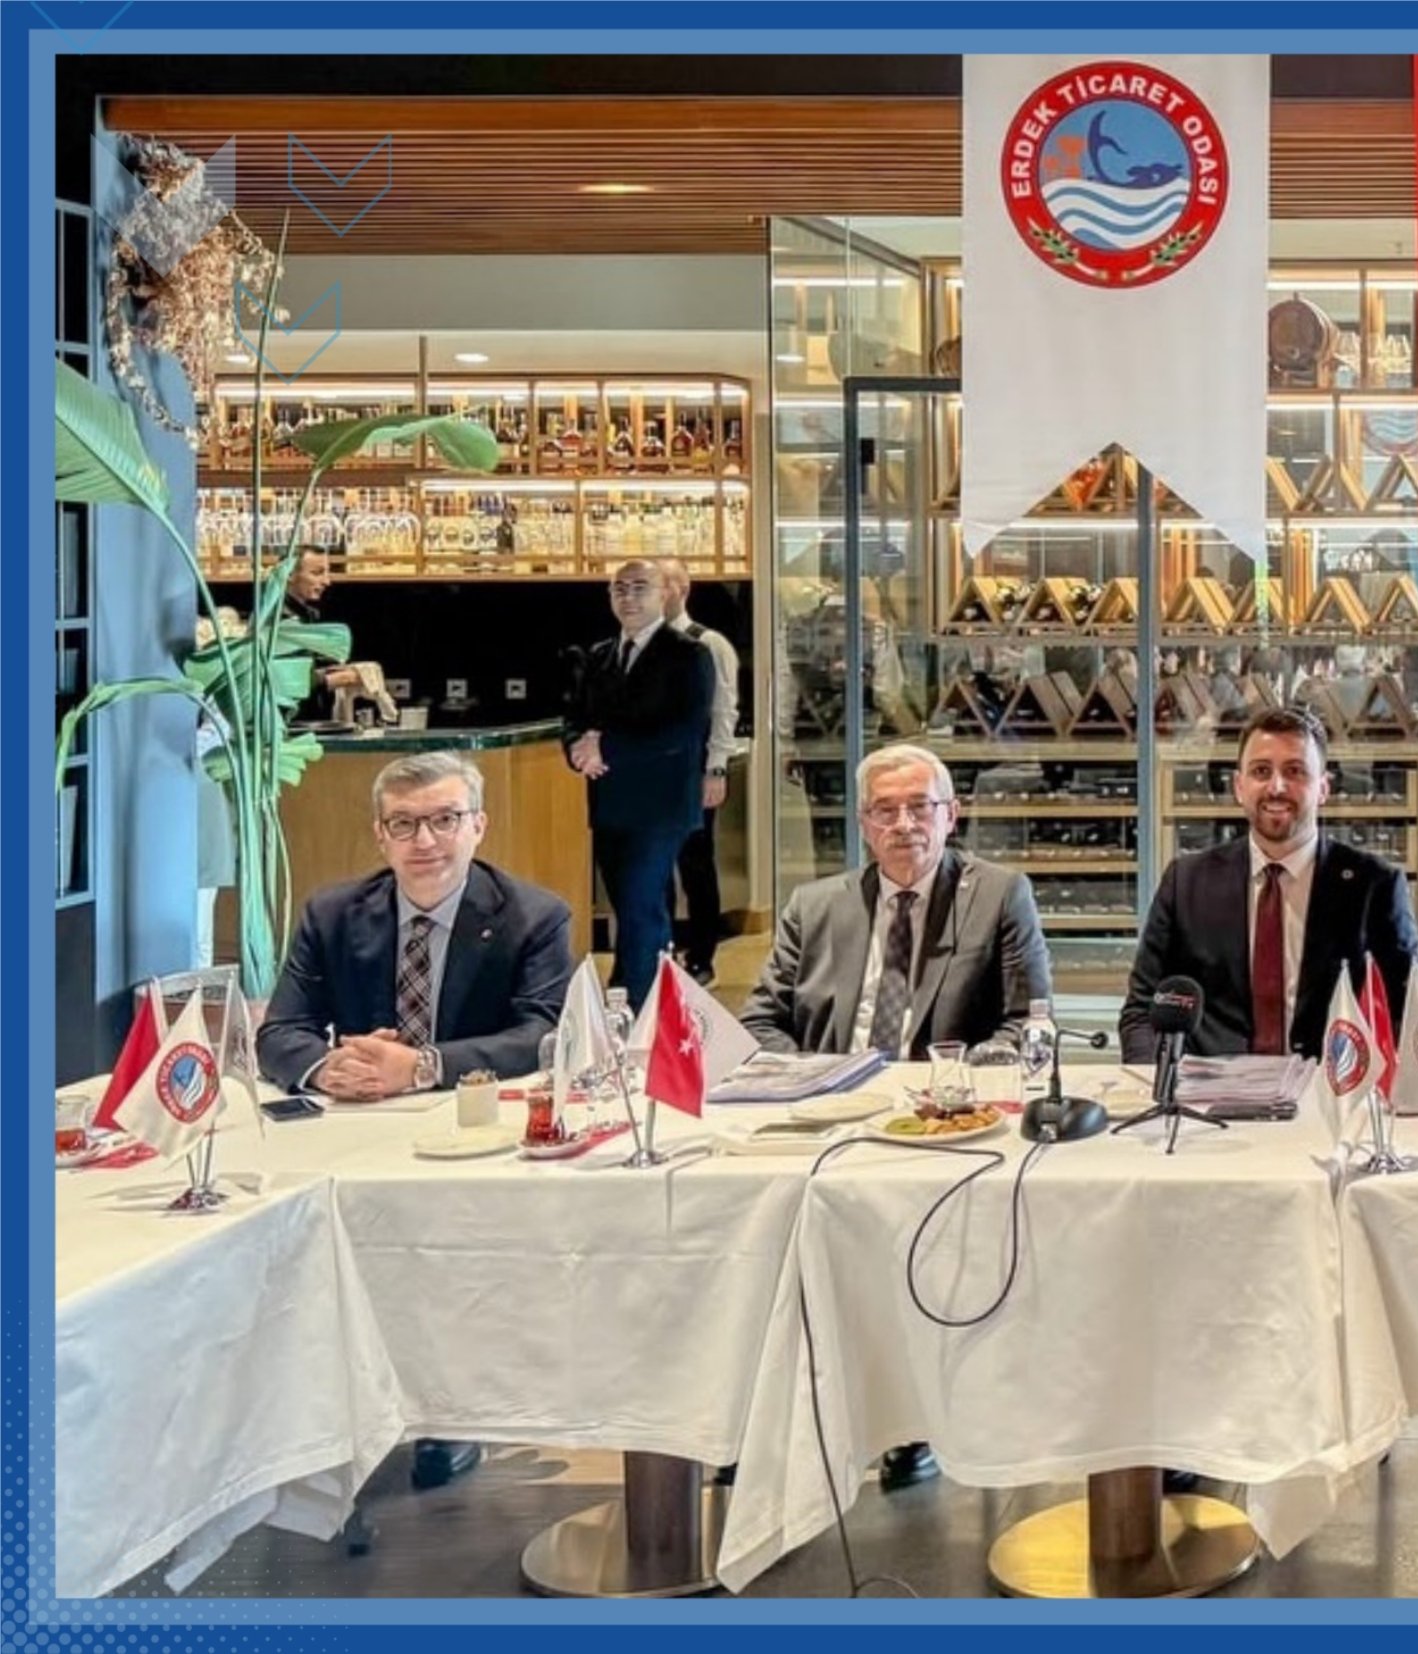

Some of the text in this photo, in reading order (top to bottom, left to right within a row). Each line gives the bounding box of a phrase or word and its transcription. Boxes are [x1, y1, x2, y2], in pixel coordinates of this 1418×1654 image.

[1010, 74, 1218, 205] ERDEK TİCARET ODASI
